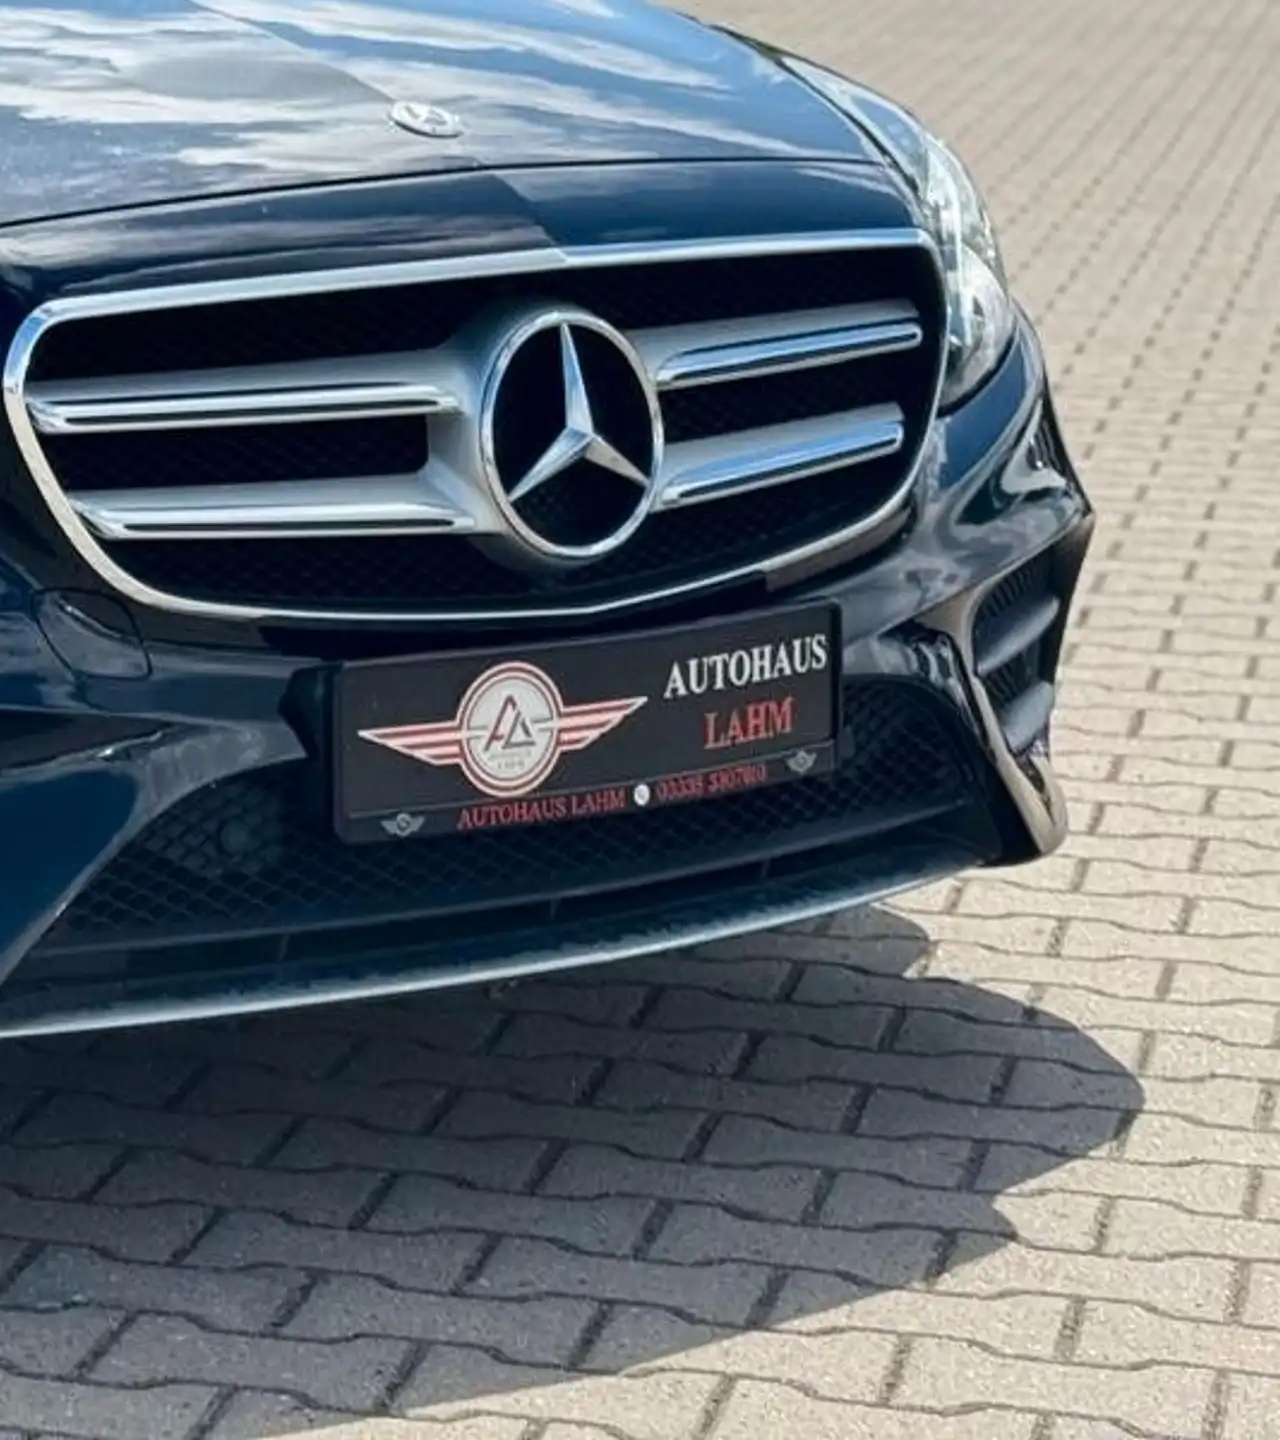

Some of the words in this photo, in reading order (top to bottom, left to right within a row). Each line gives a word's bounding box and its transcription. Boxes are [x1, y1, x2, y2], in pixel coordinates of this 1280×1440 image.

[663, 633, 828, 699] AUTOHAUS
[704, 696, 796, 750] LAHM
[457, 796, 567, 830] AUTOHAUS
[571, 787, 626, 820] LAHM
